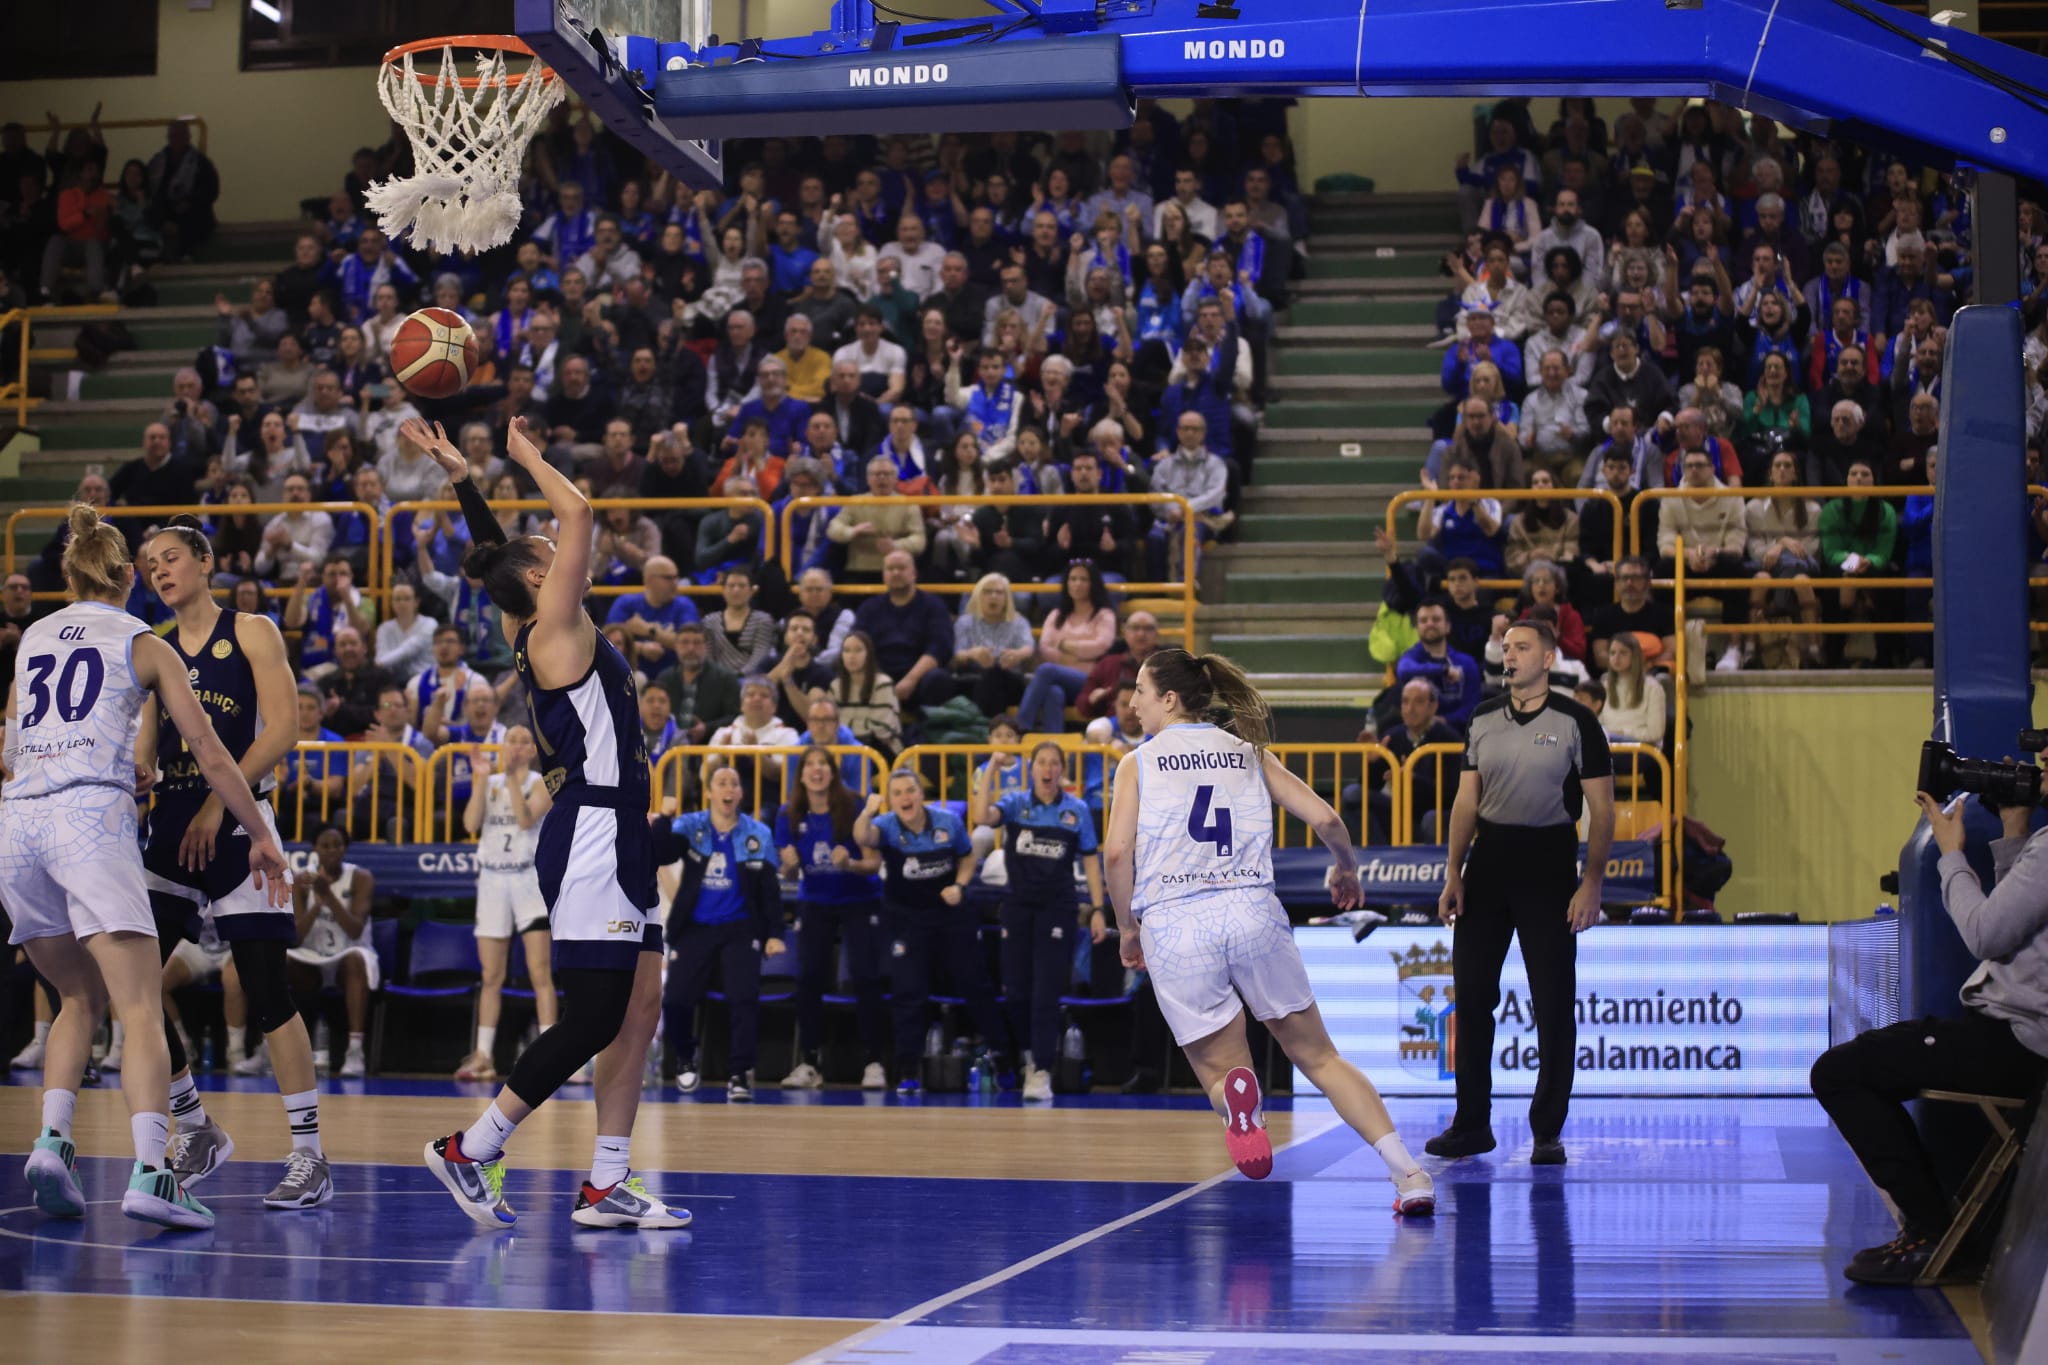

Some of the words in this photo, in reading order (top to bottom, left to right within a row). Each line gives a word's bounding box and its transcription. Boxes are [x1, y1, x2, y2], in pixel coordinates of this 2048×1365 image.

[1184, 38, 1286, 60] MONDO
[849, 63, 949, 87] MONDO
[58, 625, 87, 641] GIL
[22, 646, 105, 730] 30
[1157, 750, 1247, 772] RODRÍGUEZ
[1187, 784, 1233, 857] 4
[1162, 871, 1216, 884] CASTILLA
[1221, 871, 1229, 880] Y
[607, 920, 640, 933] DSV
[1500, 989, 1743, 1033] Ayntamiento
[1500, 1036, 1542, 1071] de
[1576, 1036, 1742, 1071] alamanca
